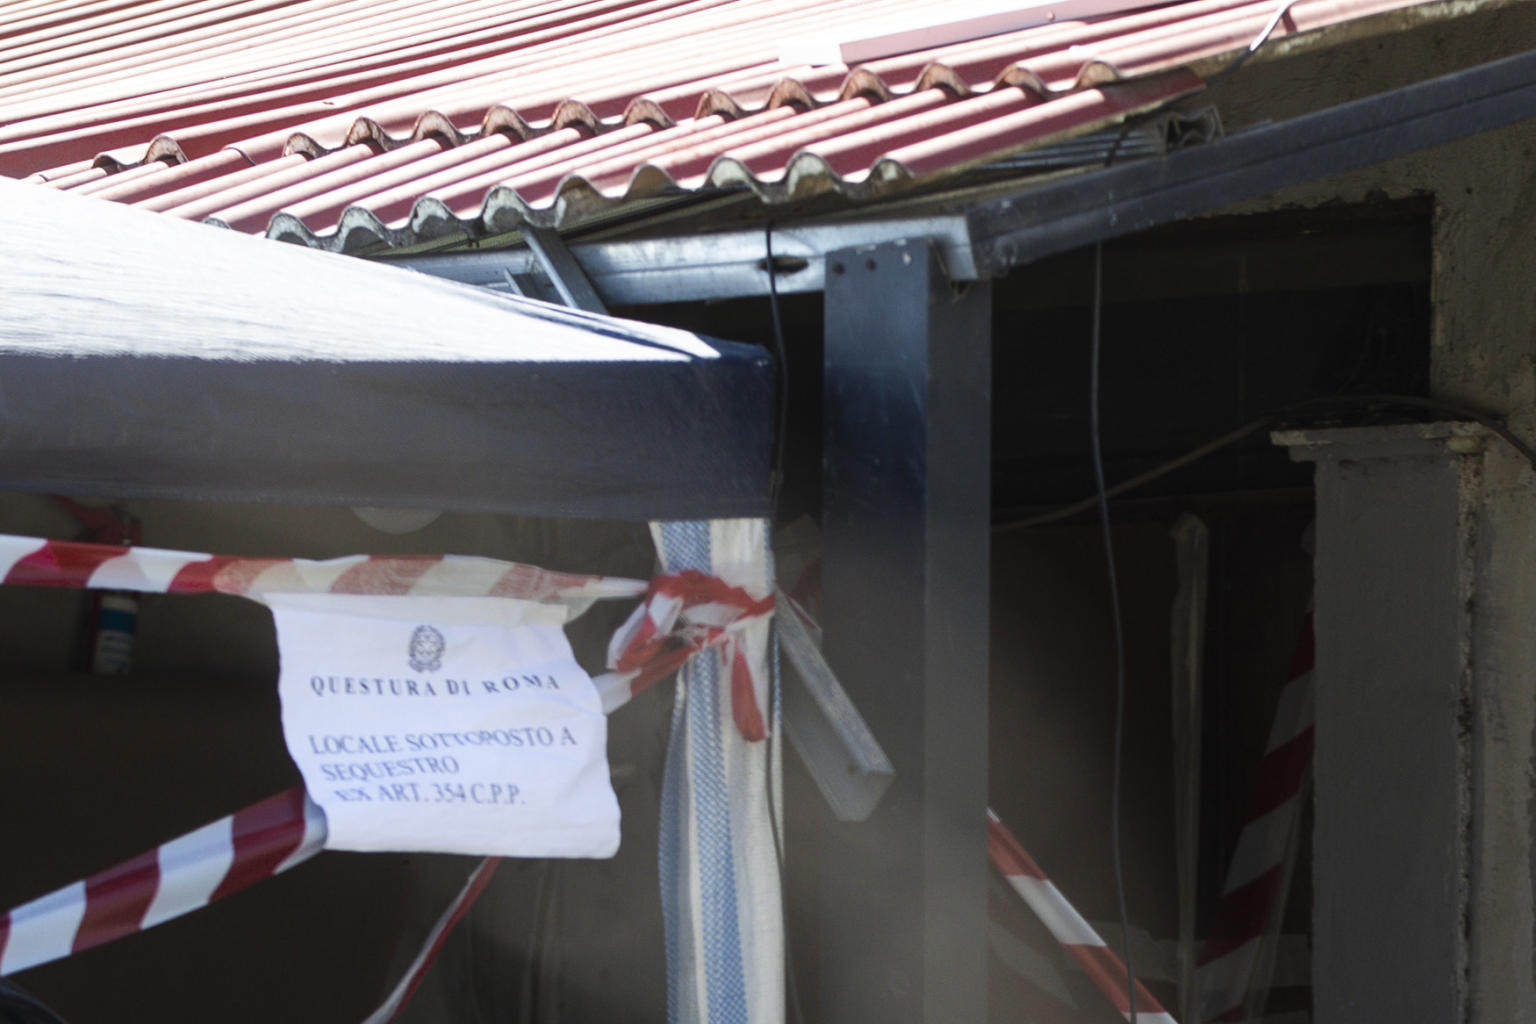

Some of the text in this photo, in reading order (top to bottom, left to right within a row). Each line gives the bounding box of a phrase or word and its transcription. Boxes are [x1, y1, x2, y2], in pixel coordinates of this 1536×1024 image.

[310, 674, 561, 697] QUESTURA DI ROMA
[308, 726, 578, 755] LOCALE SOTTOPOSTO A
[320, 755, 460, 782] SEQUESTRO
[377, 783, 431, 803] ART.
